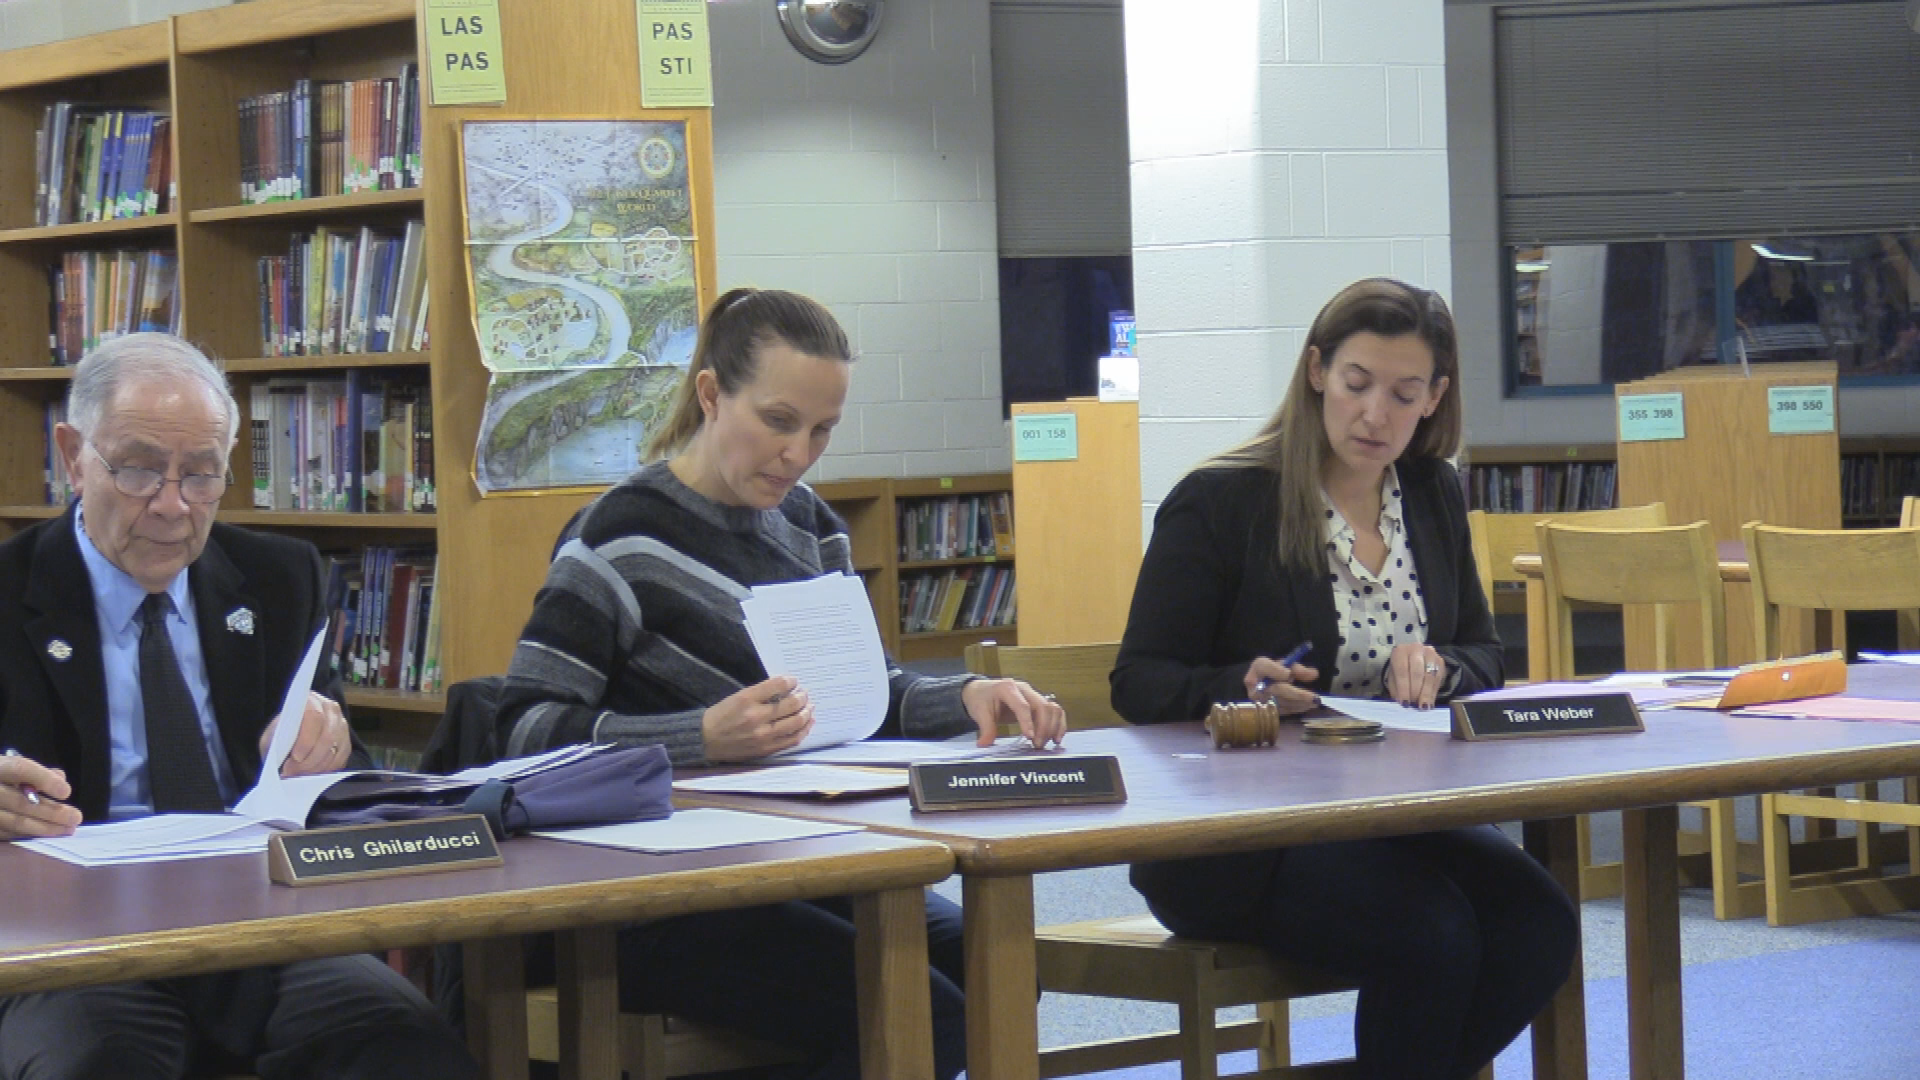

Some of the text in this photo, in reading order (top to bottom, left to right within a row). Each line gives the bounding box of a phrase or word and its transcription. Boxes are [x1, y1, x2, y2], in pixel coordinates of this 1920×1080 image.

[441, 16, 483, 35] LAS
[652, 22, 693, 40] PAS
[446, 52, 489, 70] PAS
[660, 58, 692, 75] STI
[1653, 409, 1673, 419] 398
[1776, 400, 1823, 411] 398 550
[1022, 428, 1066, 439] 001 158
[1503, 707, 1594, 723] Tara Weber
[948, 770, 1085, 788] Jennifer Vincent
[300, 832, 481, 863] Chris Ghilarducci
